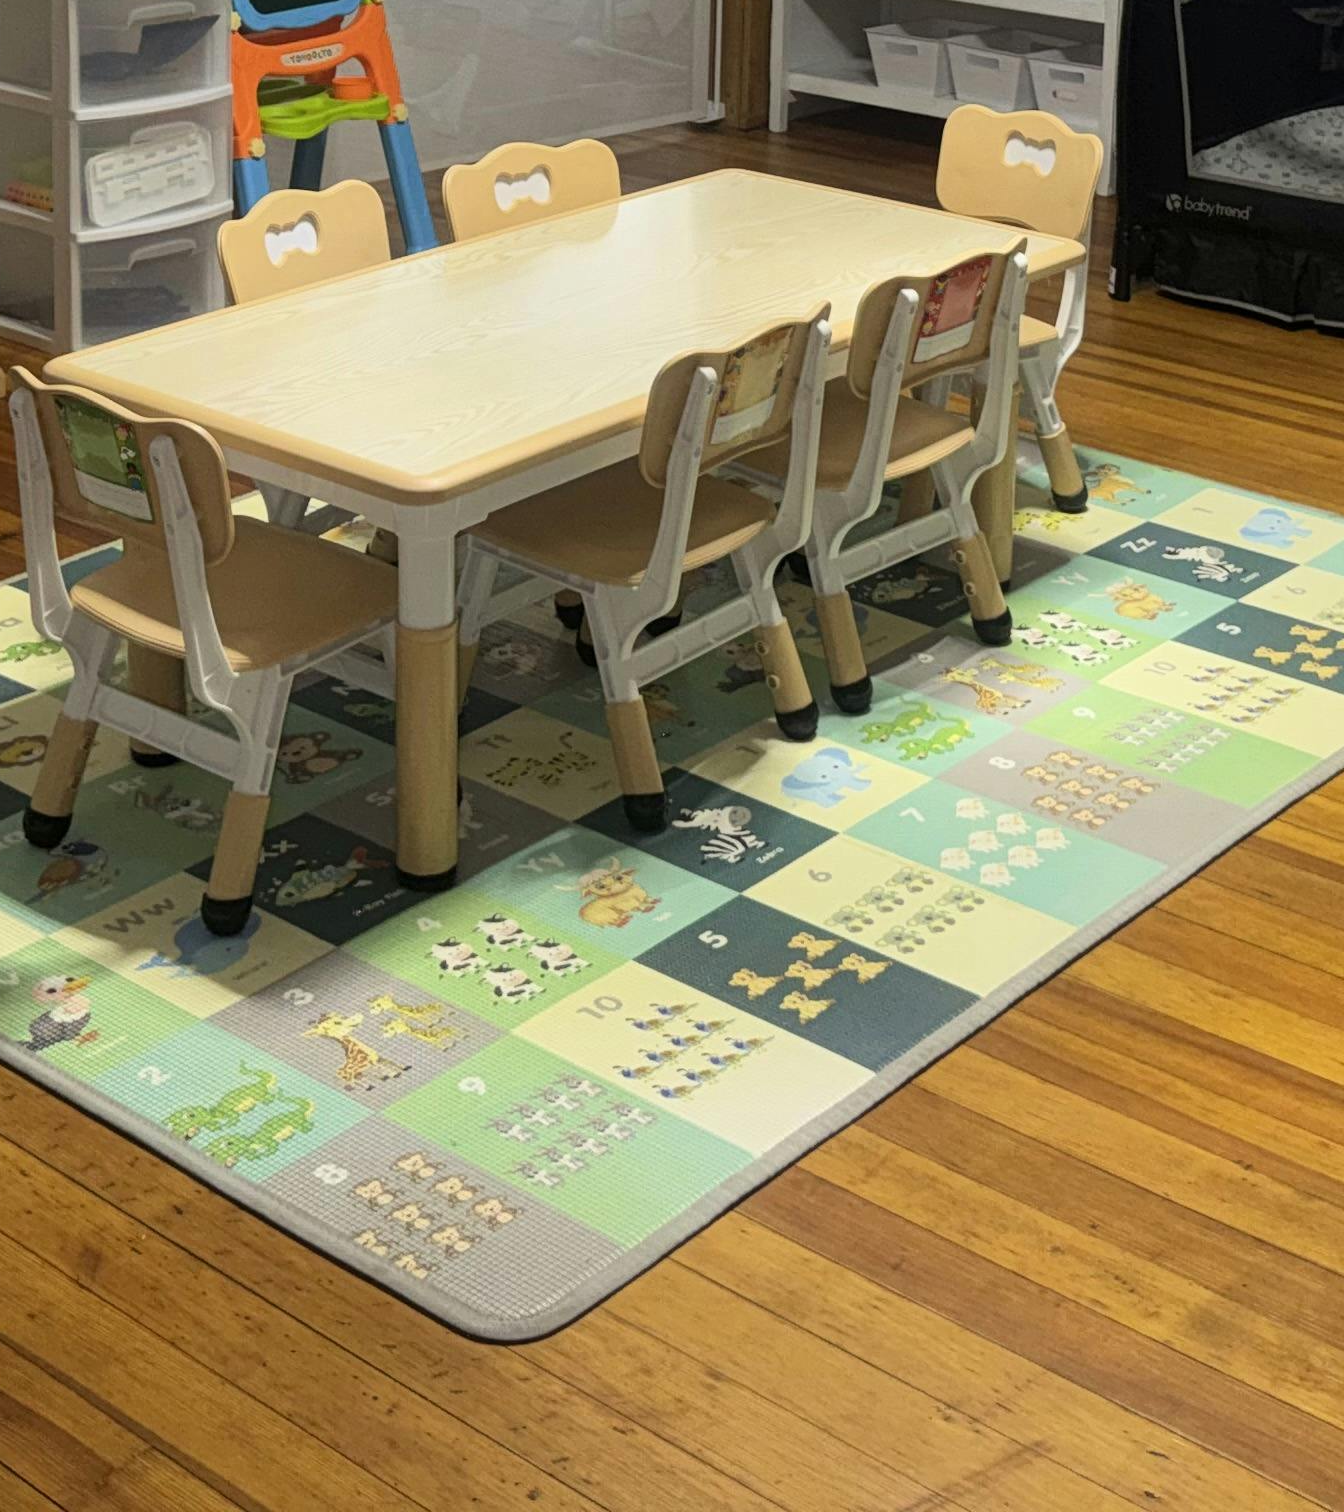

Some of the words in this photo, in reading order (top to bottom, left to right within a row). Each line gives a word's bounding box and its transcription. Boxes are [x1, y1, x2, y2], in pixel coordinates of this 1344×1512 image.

[1216, 622, 1242, 635] 5
[1145, 660, 1177, 676] 10
[1072, 707, 1096, 719] 9
[988, 756, 1016, 770] 8
[899, 807, 926, 823] 7
[756, 846, 784, 864] Zebra
[808, 869, 833, 882] 6
[102, 896, 176, 934] Ww
[416, 916, 443, 932] 4
[698, 930, 729, 949] 5
[576, 995, 624, 1019] 10
[136, 1066, 172, 1086] 2
[457, 1076, 487, 1096] 9
[313, 1163, 349, 1185] 8
